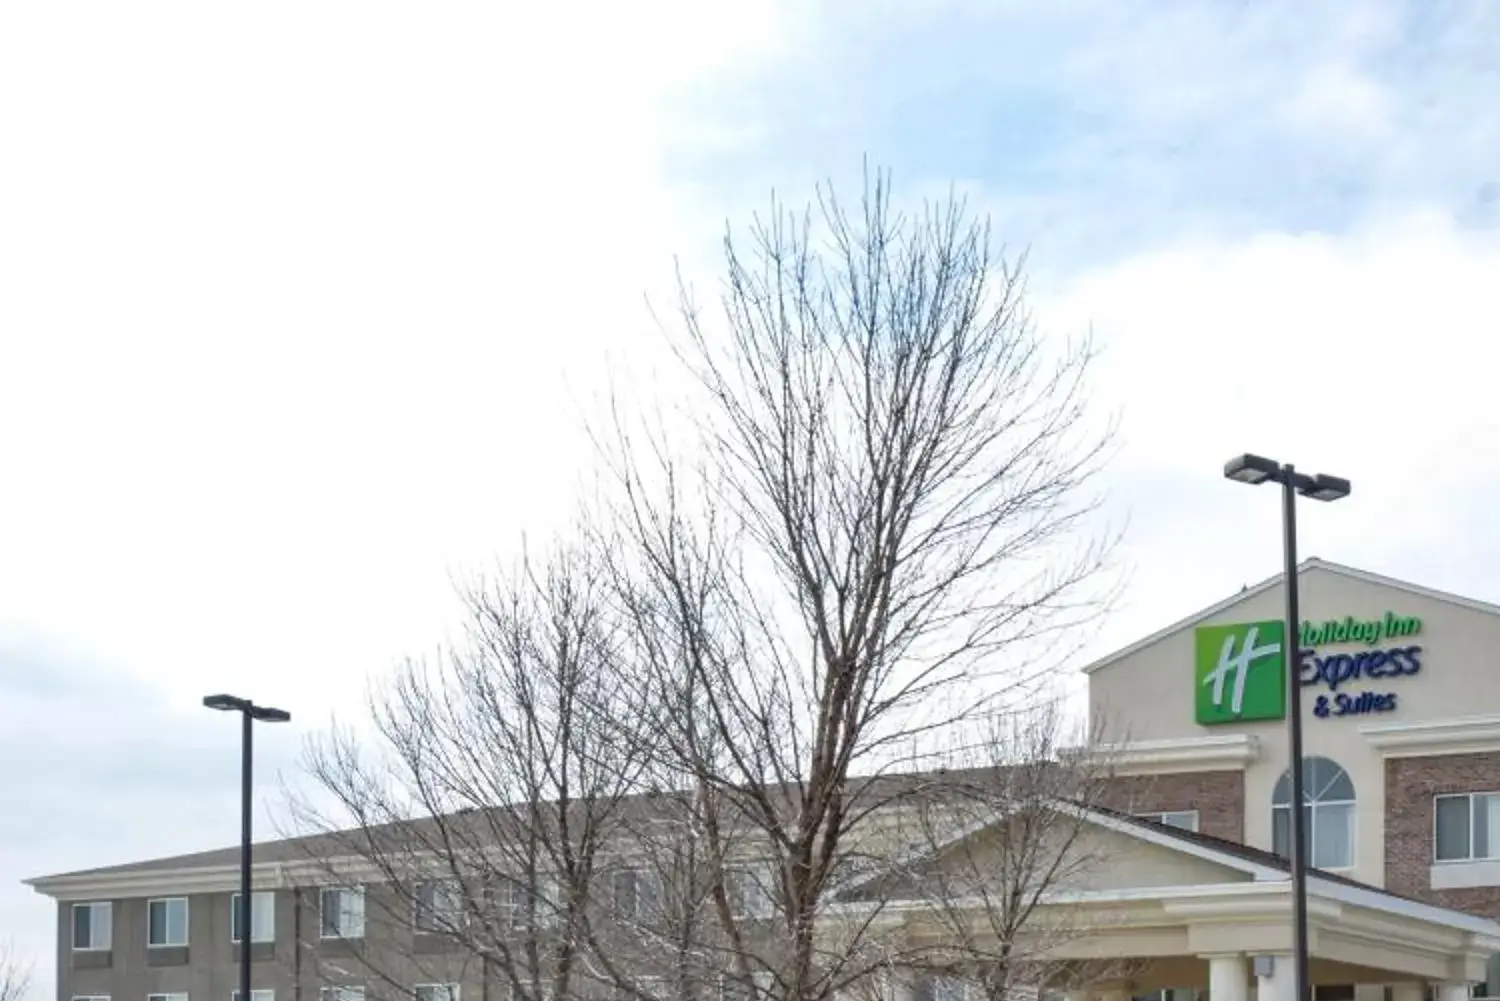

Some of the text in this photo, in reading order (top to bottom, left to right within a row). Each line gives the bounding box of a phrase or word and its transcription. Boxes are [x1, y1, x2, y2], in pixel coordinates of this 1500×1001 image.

[1384, 611, 1421, 638] Inn
[1299, 645, 1422, 690] Express
[1313, 691, 1397, 717] & Suites
